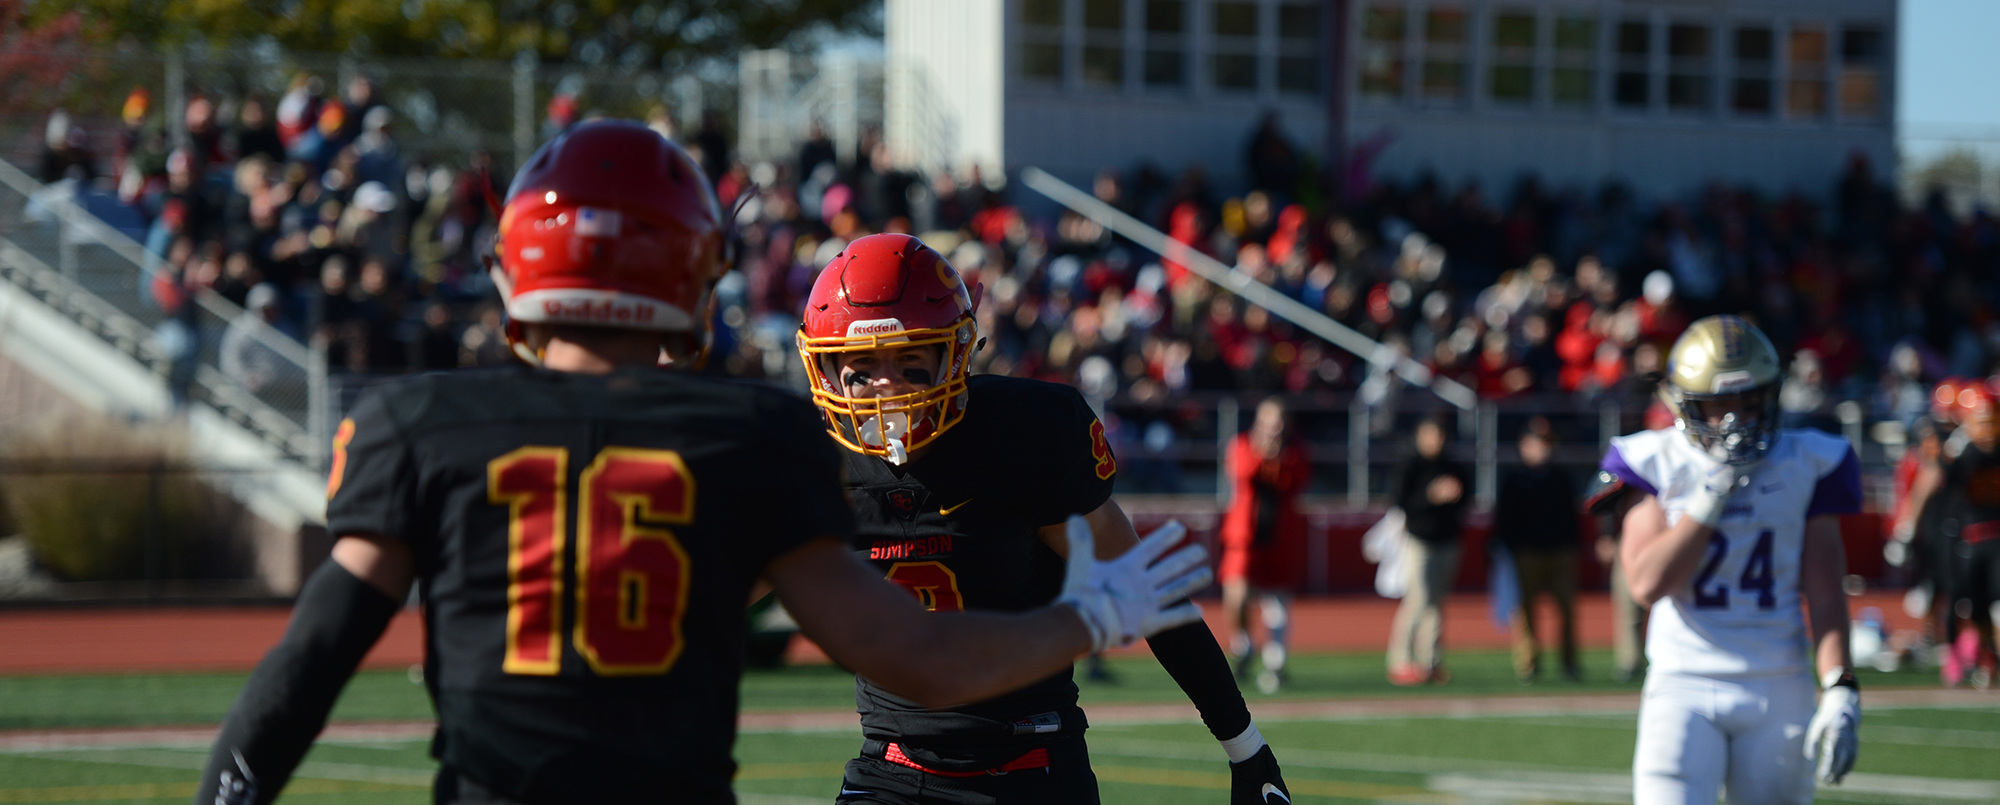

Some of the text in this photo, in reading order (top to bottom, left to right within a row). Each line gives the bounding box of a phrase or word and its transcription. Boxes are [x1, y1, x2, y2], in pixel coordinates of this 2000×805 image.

[853, 323, 897, 335] Riddell
[1089, 417, 1117, 481] 9
[487, 446, 696, 676] 16
[870, 535, 953, 560] SIMPSON
[1693, 527, 1777, 611] 24
